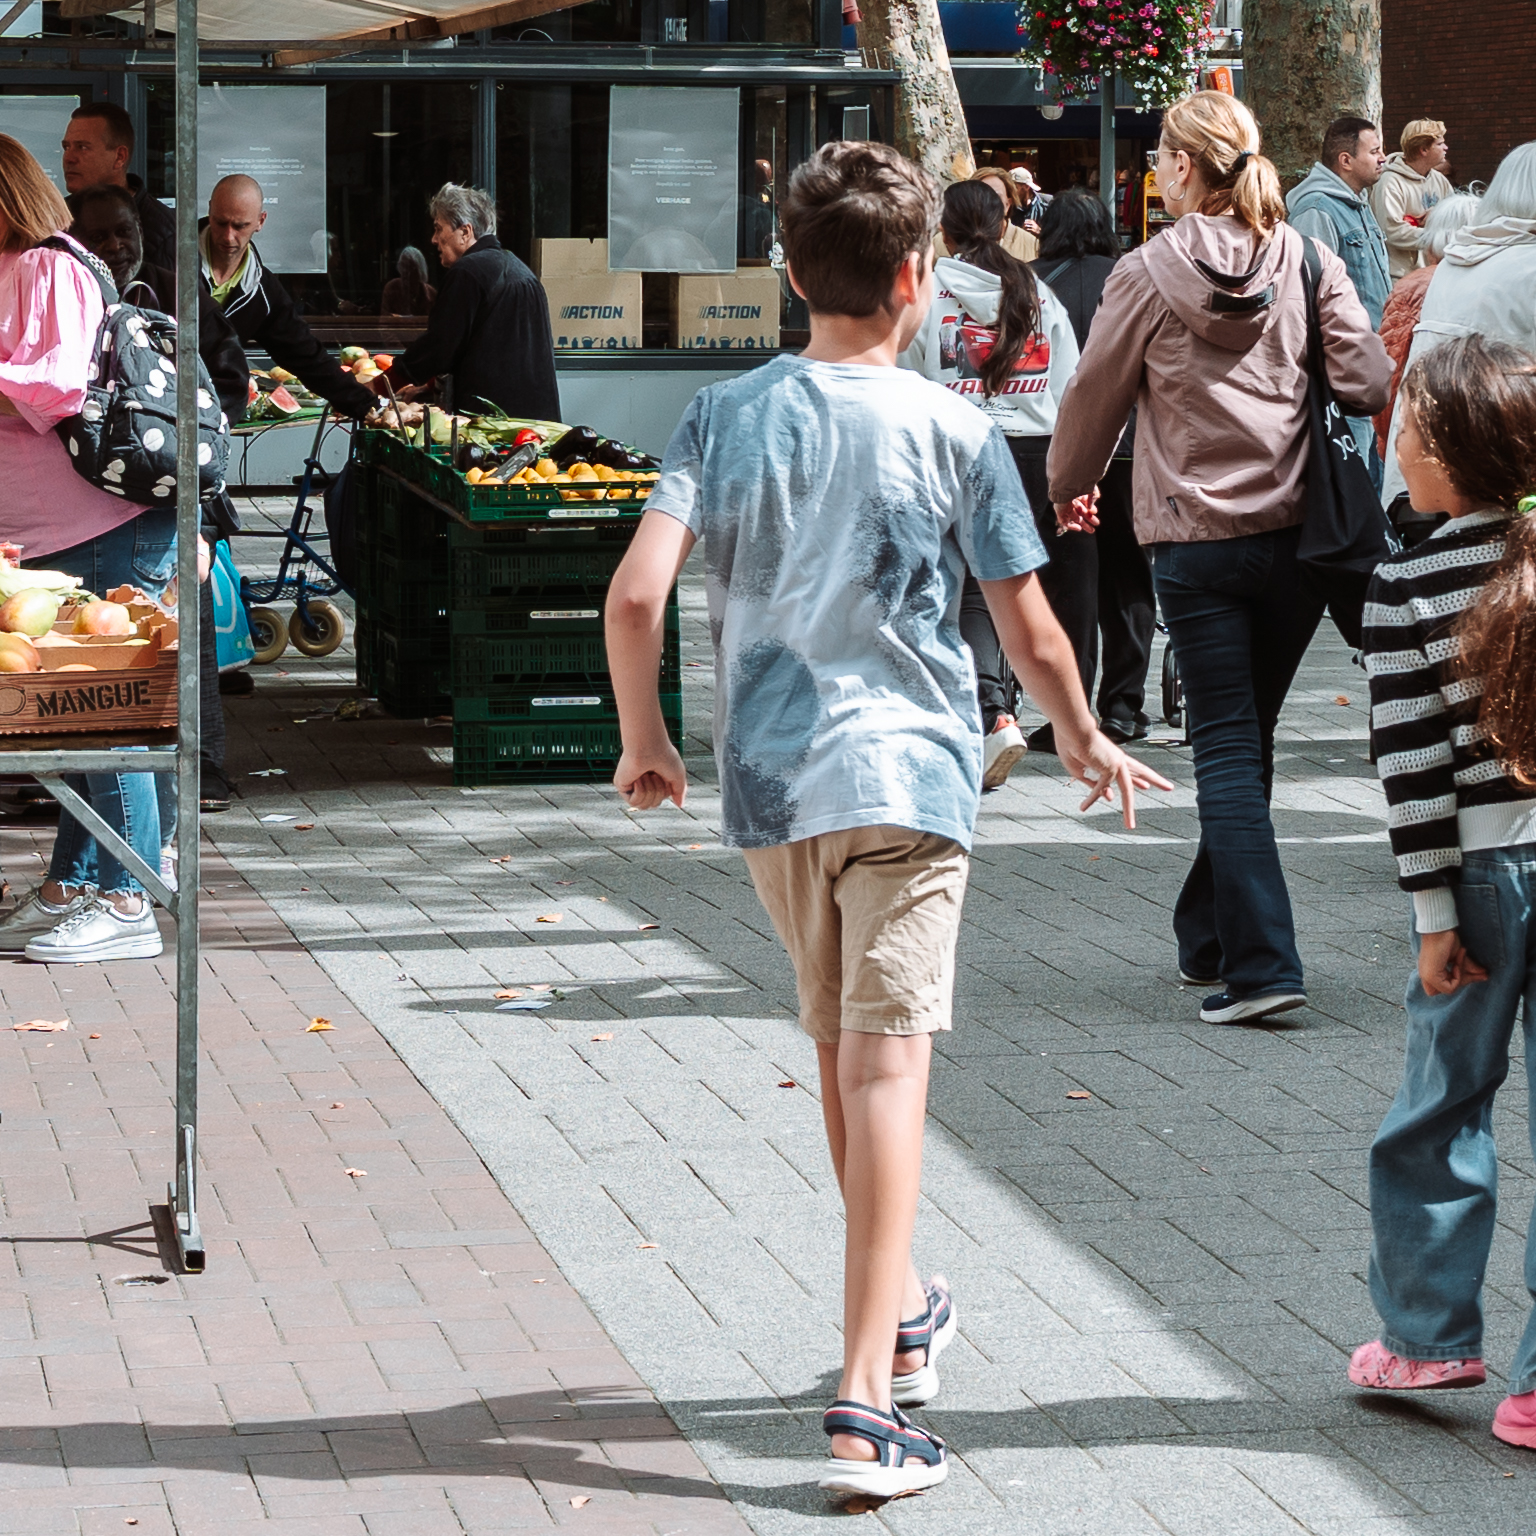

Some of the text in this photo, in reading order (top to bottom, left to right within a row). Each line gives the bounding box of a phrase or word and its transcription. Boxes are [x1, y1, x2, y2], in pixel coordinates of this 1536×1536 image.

[566, 305, 624, 320] ACTION
[704, 305, 762, 320] ACTION
[36, 679, 152, 718] MANGUE
